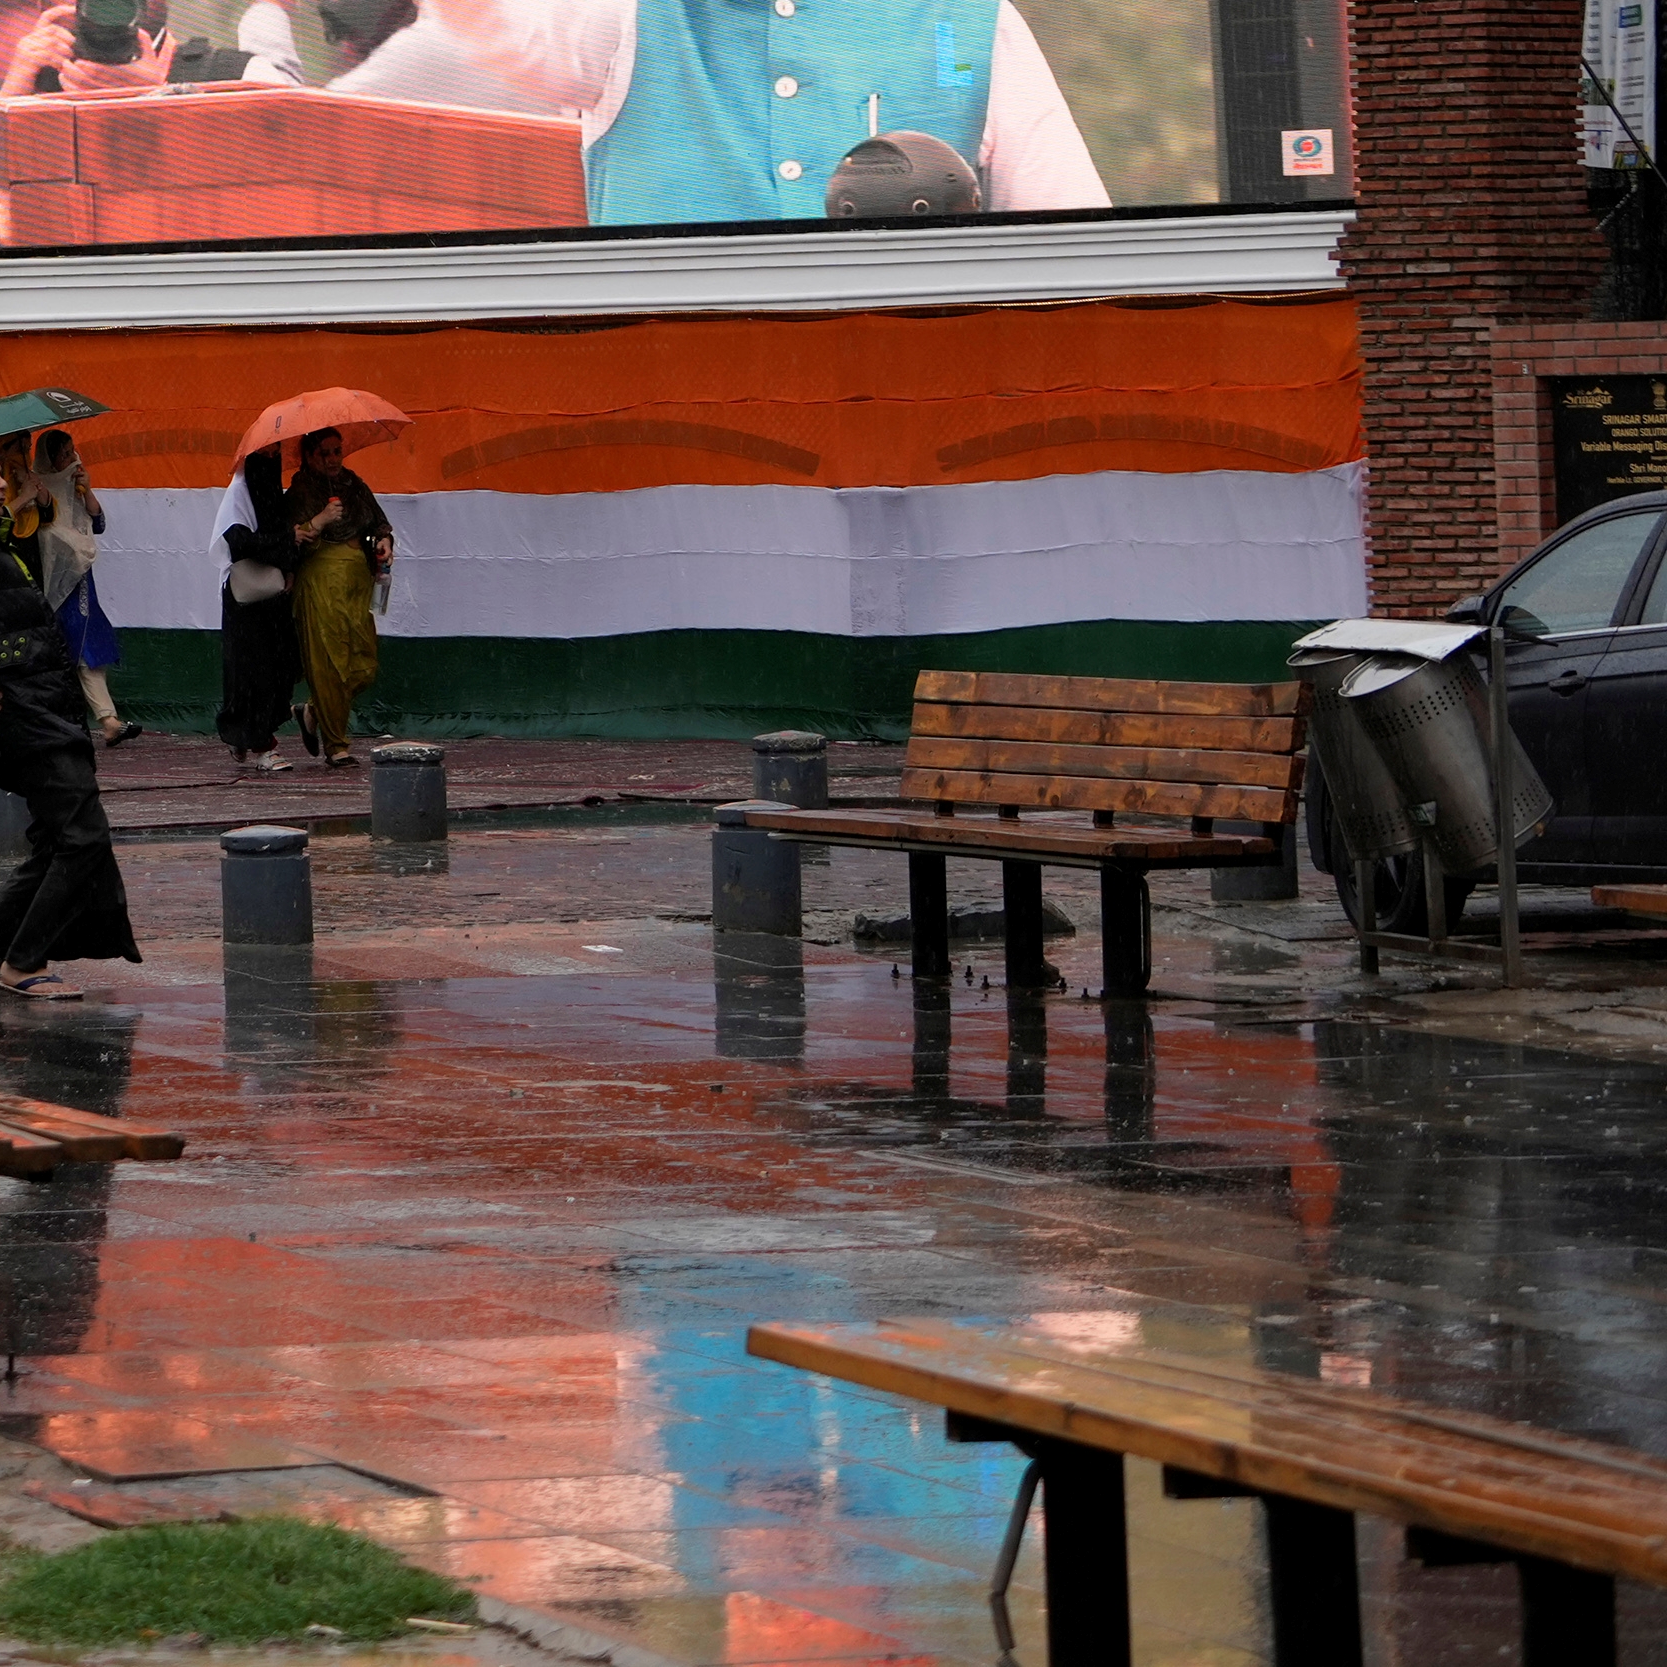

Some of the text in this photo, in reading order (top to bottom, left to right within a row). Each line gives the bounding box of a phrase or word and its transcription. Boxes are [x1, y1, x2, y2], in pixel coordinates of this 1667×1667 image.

[1562, 391, 1614, 409] Srinagar
[1602, 415, 1641, 425] SRINAGAR
[1580, 441, 1612, 451] Variable
[1612, 440, 1654, 453] Messaging
[1629, 463, 1646, 473] Shri
